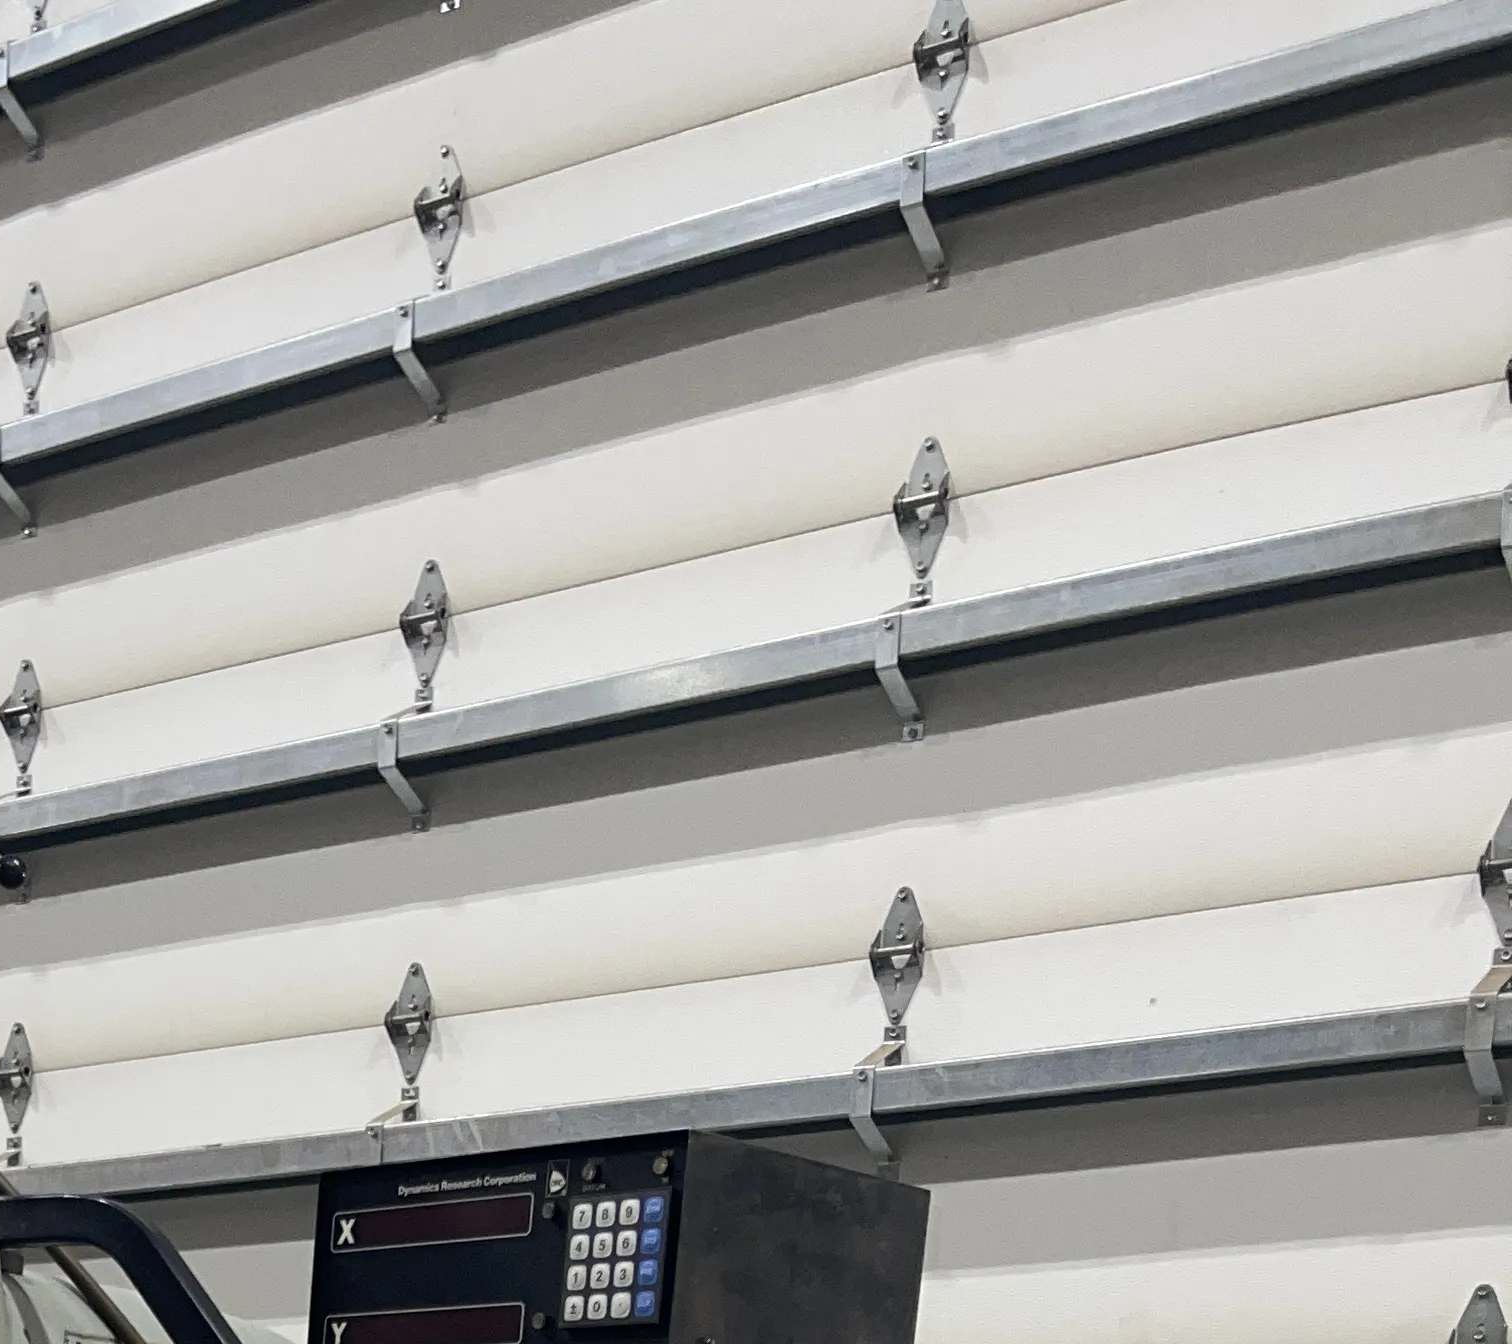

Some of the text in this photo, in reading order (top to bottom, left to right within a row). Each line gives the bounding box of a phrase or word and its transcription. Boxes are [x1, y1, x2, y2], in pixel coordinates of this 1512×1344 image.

[398, 1172, 537, 1197] Dynamics Research Corporation
[579, 1211, 586, 1223] 7
[601, 1209, 609, 1220] 8
[625, 1206, 633, 1218] 9
[337, 1218, 356, 1245] X
[575, 1242, 582, 1253] 4
[599, 1239, 606, 1251] 5
[622, 1237, 630, 1249] 6
[573, 1272, 579, 1284] 1
[595, 1270, 603, 1282] 2
[619, 1268, 627, 1280] 3
[593, 1301, 600, 1313] 0
